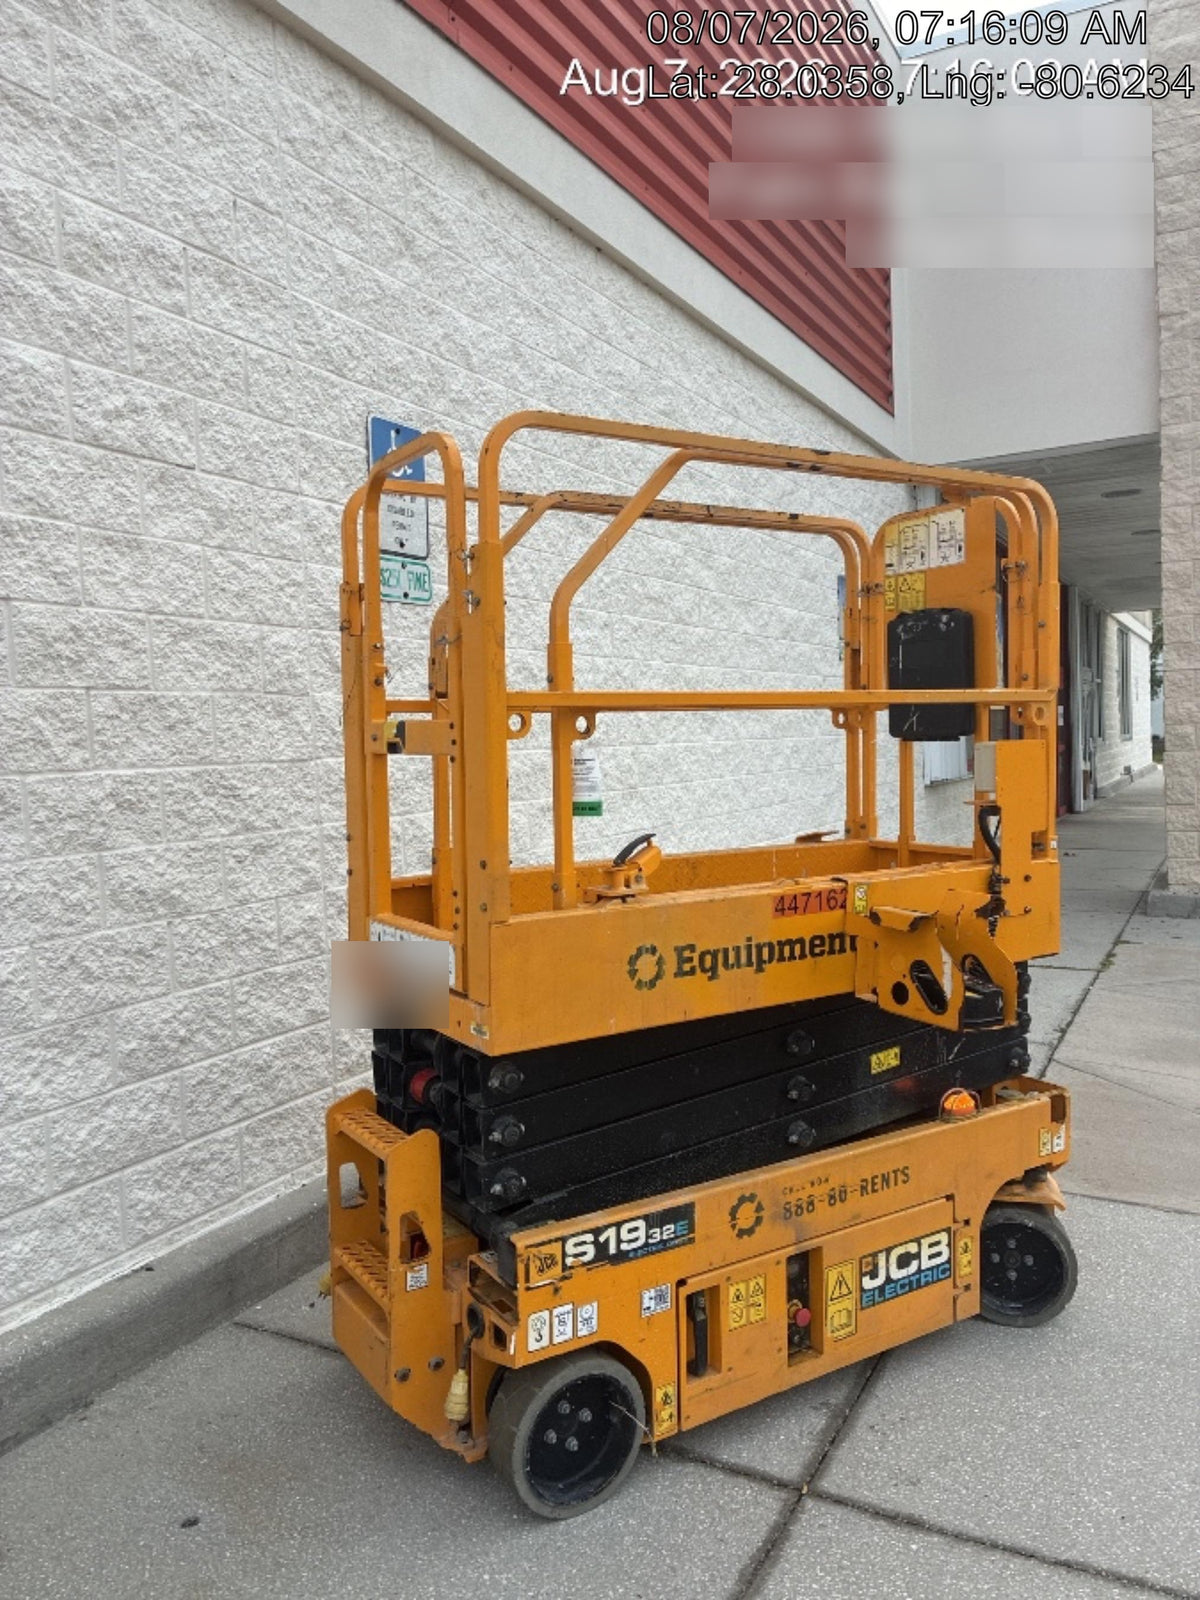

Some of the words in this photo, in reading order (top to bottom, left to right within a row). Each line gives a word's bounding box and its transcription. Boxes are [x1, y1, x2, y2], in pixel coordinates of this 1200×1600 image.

[774, 888, 848, 916] 447162
[861, 1231, 950, 1290] JCB
[861, 1263, 950, 1308] ELECTRIC
